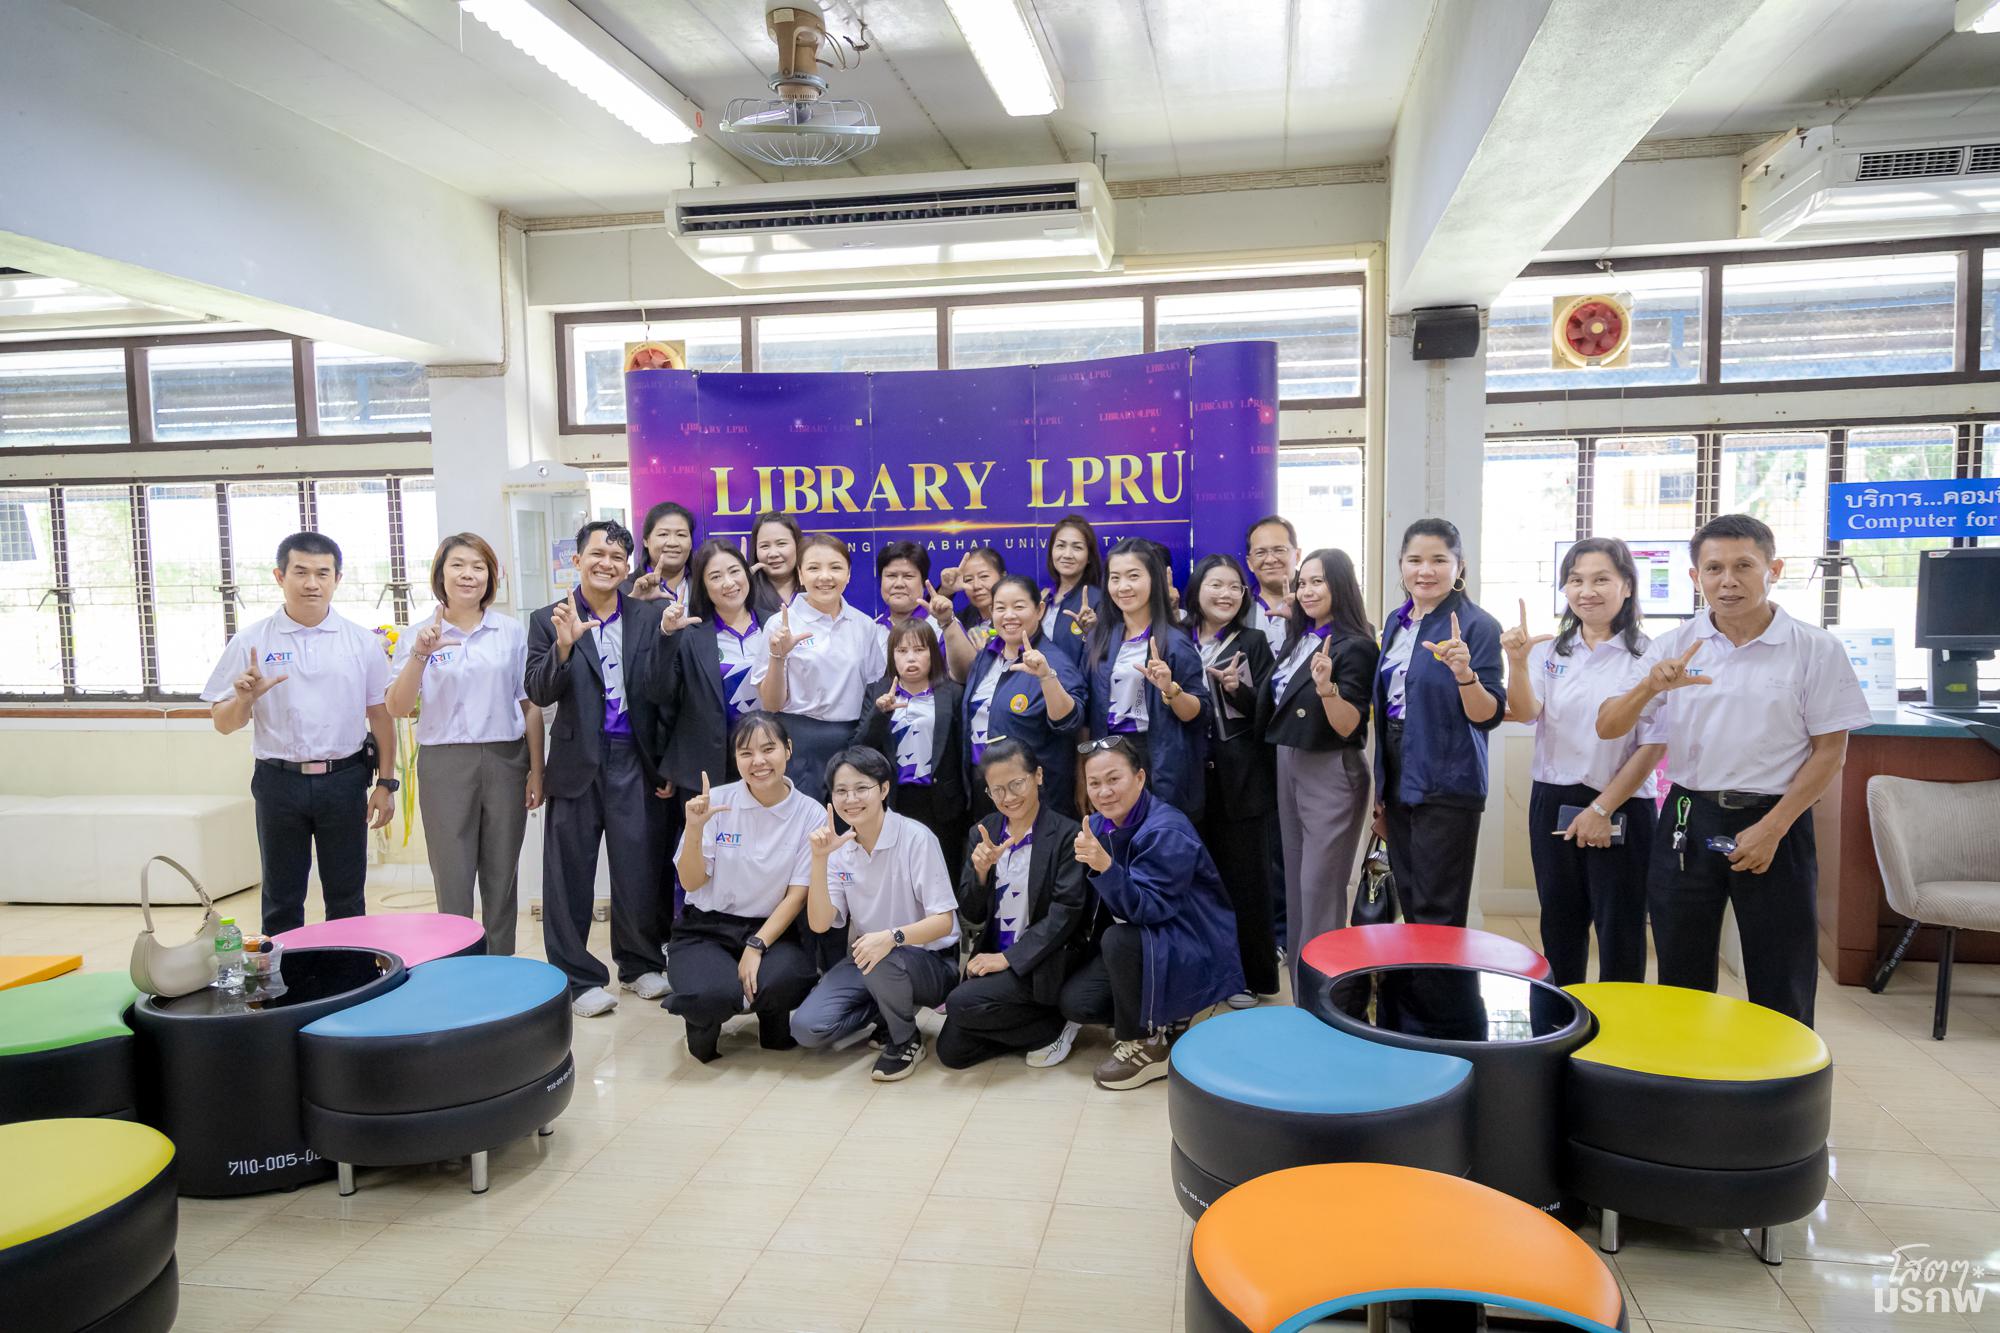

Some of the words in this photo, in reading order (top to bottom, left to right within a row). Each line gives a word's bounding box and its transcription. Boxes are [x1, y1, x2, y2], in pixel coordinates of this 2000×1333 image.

[710, 462, 997, 516] LIBRARY
[1026, 450, 1186, 509] LPRU
[1847, 513, 1957, 532] Computer
[1966, 510, 1998, 527] for
[265, 651, 292, 663] ARIT
[715, 831, 742, 844] ARIT
